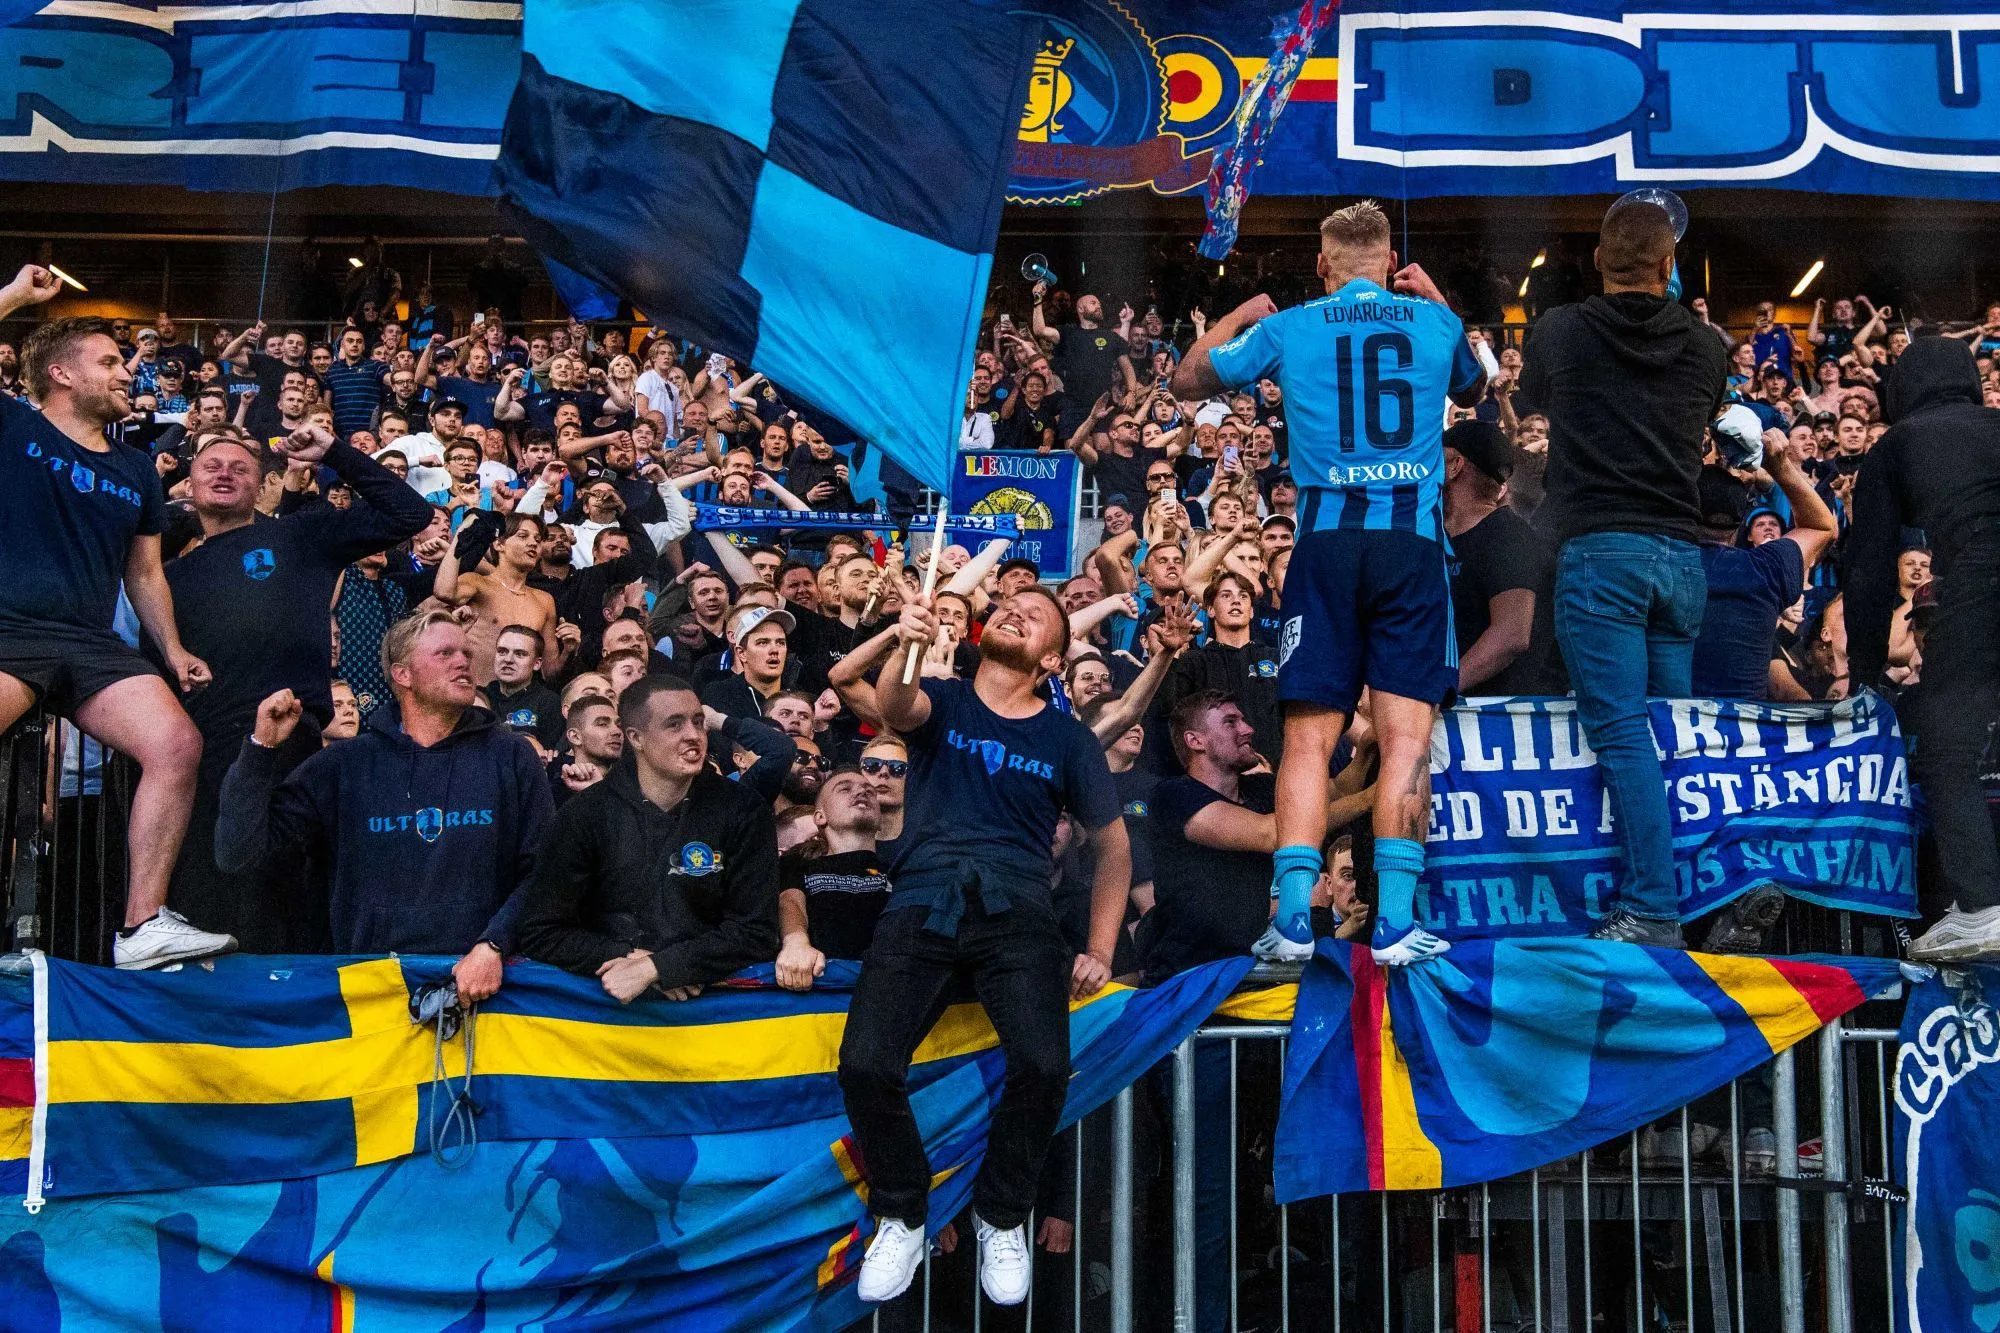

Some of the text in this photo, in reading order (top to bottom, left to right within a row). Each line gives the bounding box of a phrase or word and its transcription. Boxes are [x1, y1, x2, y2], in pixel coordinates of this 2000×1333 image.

[1323, 302, 1414, 324] EDVARDSEN
[1336, 332, 1415, 454] 16
[965, 455, 1060, 479] LEMON
[1347, 461, 1429, 484] FXORO
[1503, 788, 1579, 838] DE
